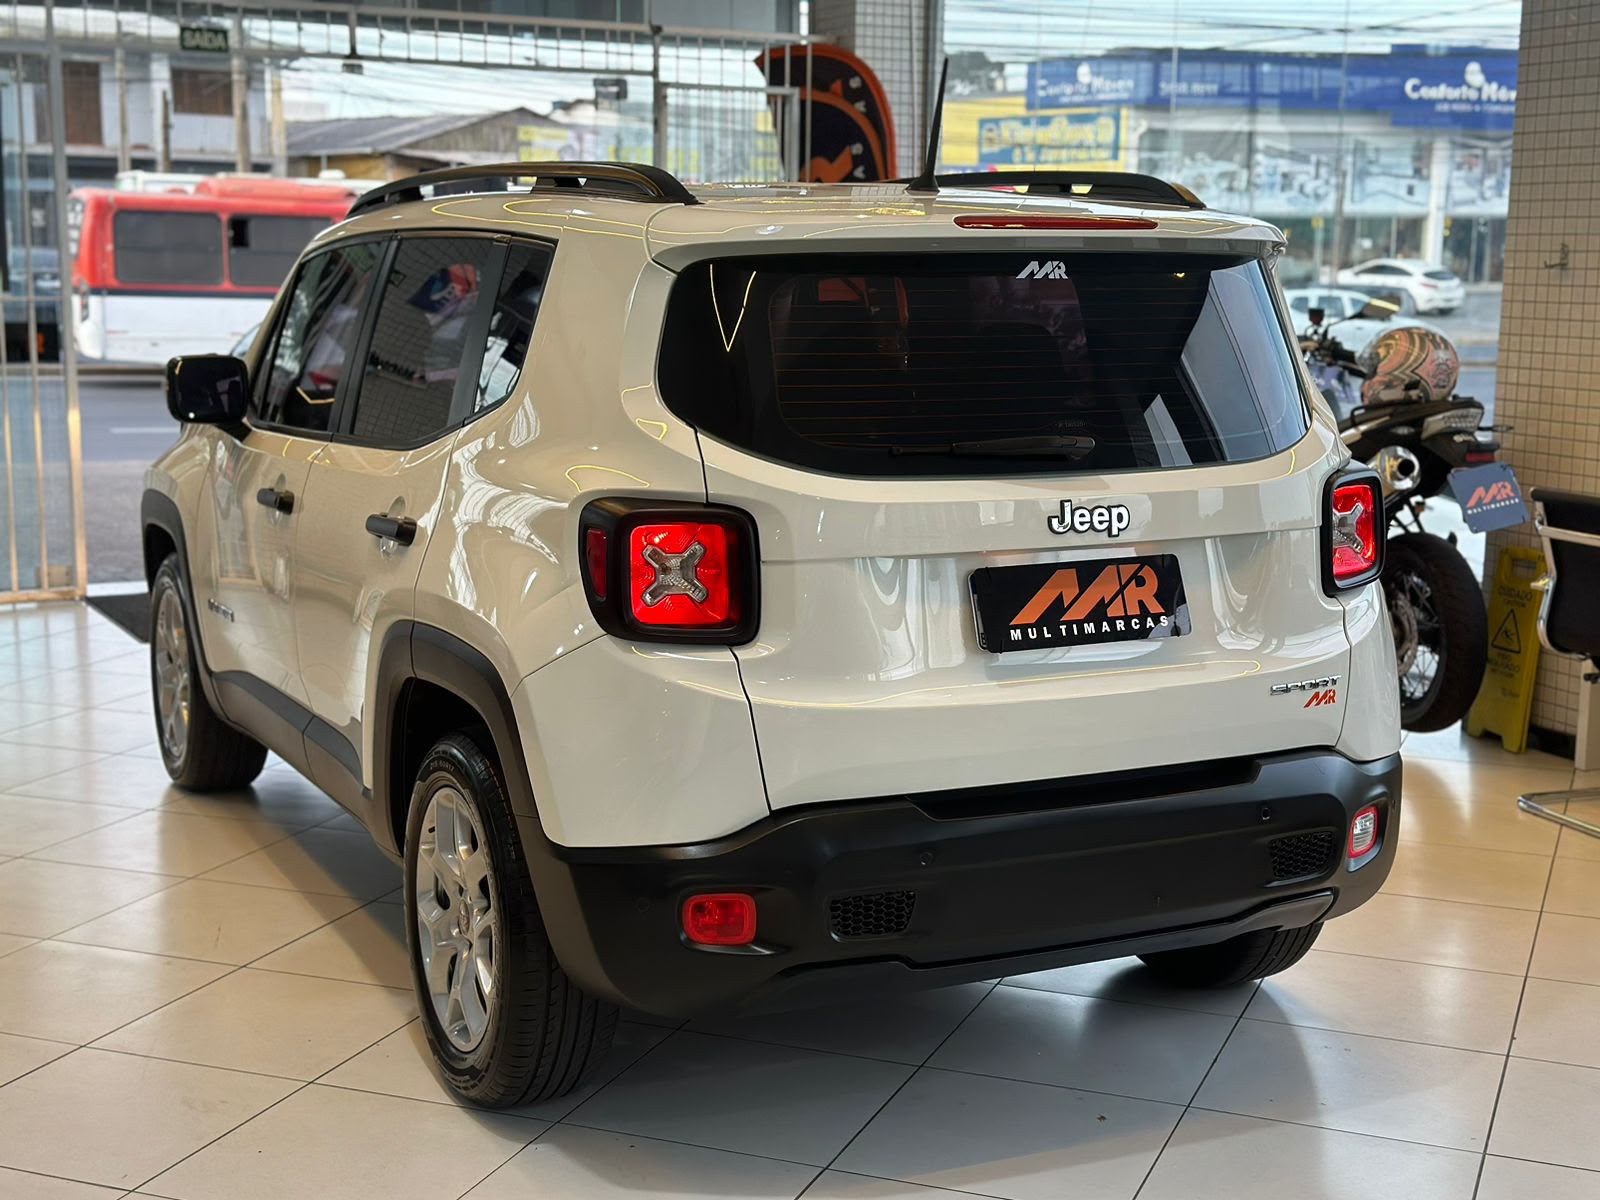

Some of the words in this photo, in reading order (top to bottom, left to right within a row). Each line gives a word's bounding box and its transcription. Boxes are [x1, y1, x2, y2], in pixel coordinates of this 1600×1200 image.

[1047, 499, 1131, 538] Jeep
[1009, 615, 1169, 642] MULTIMARCAS
[1270, 675, 1342, 696] SPORT
